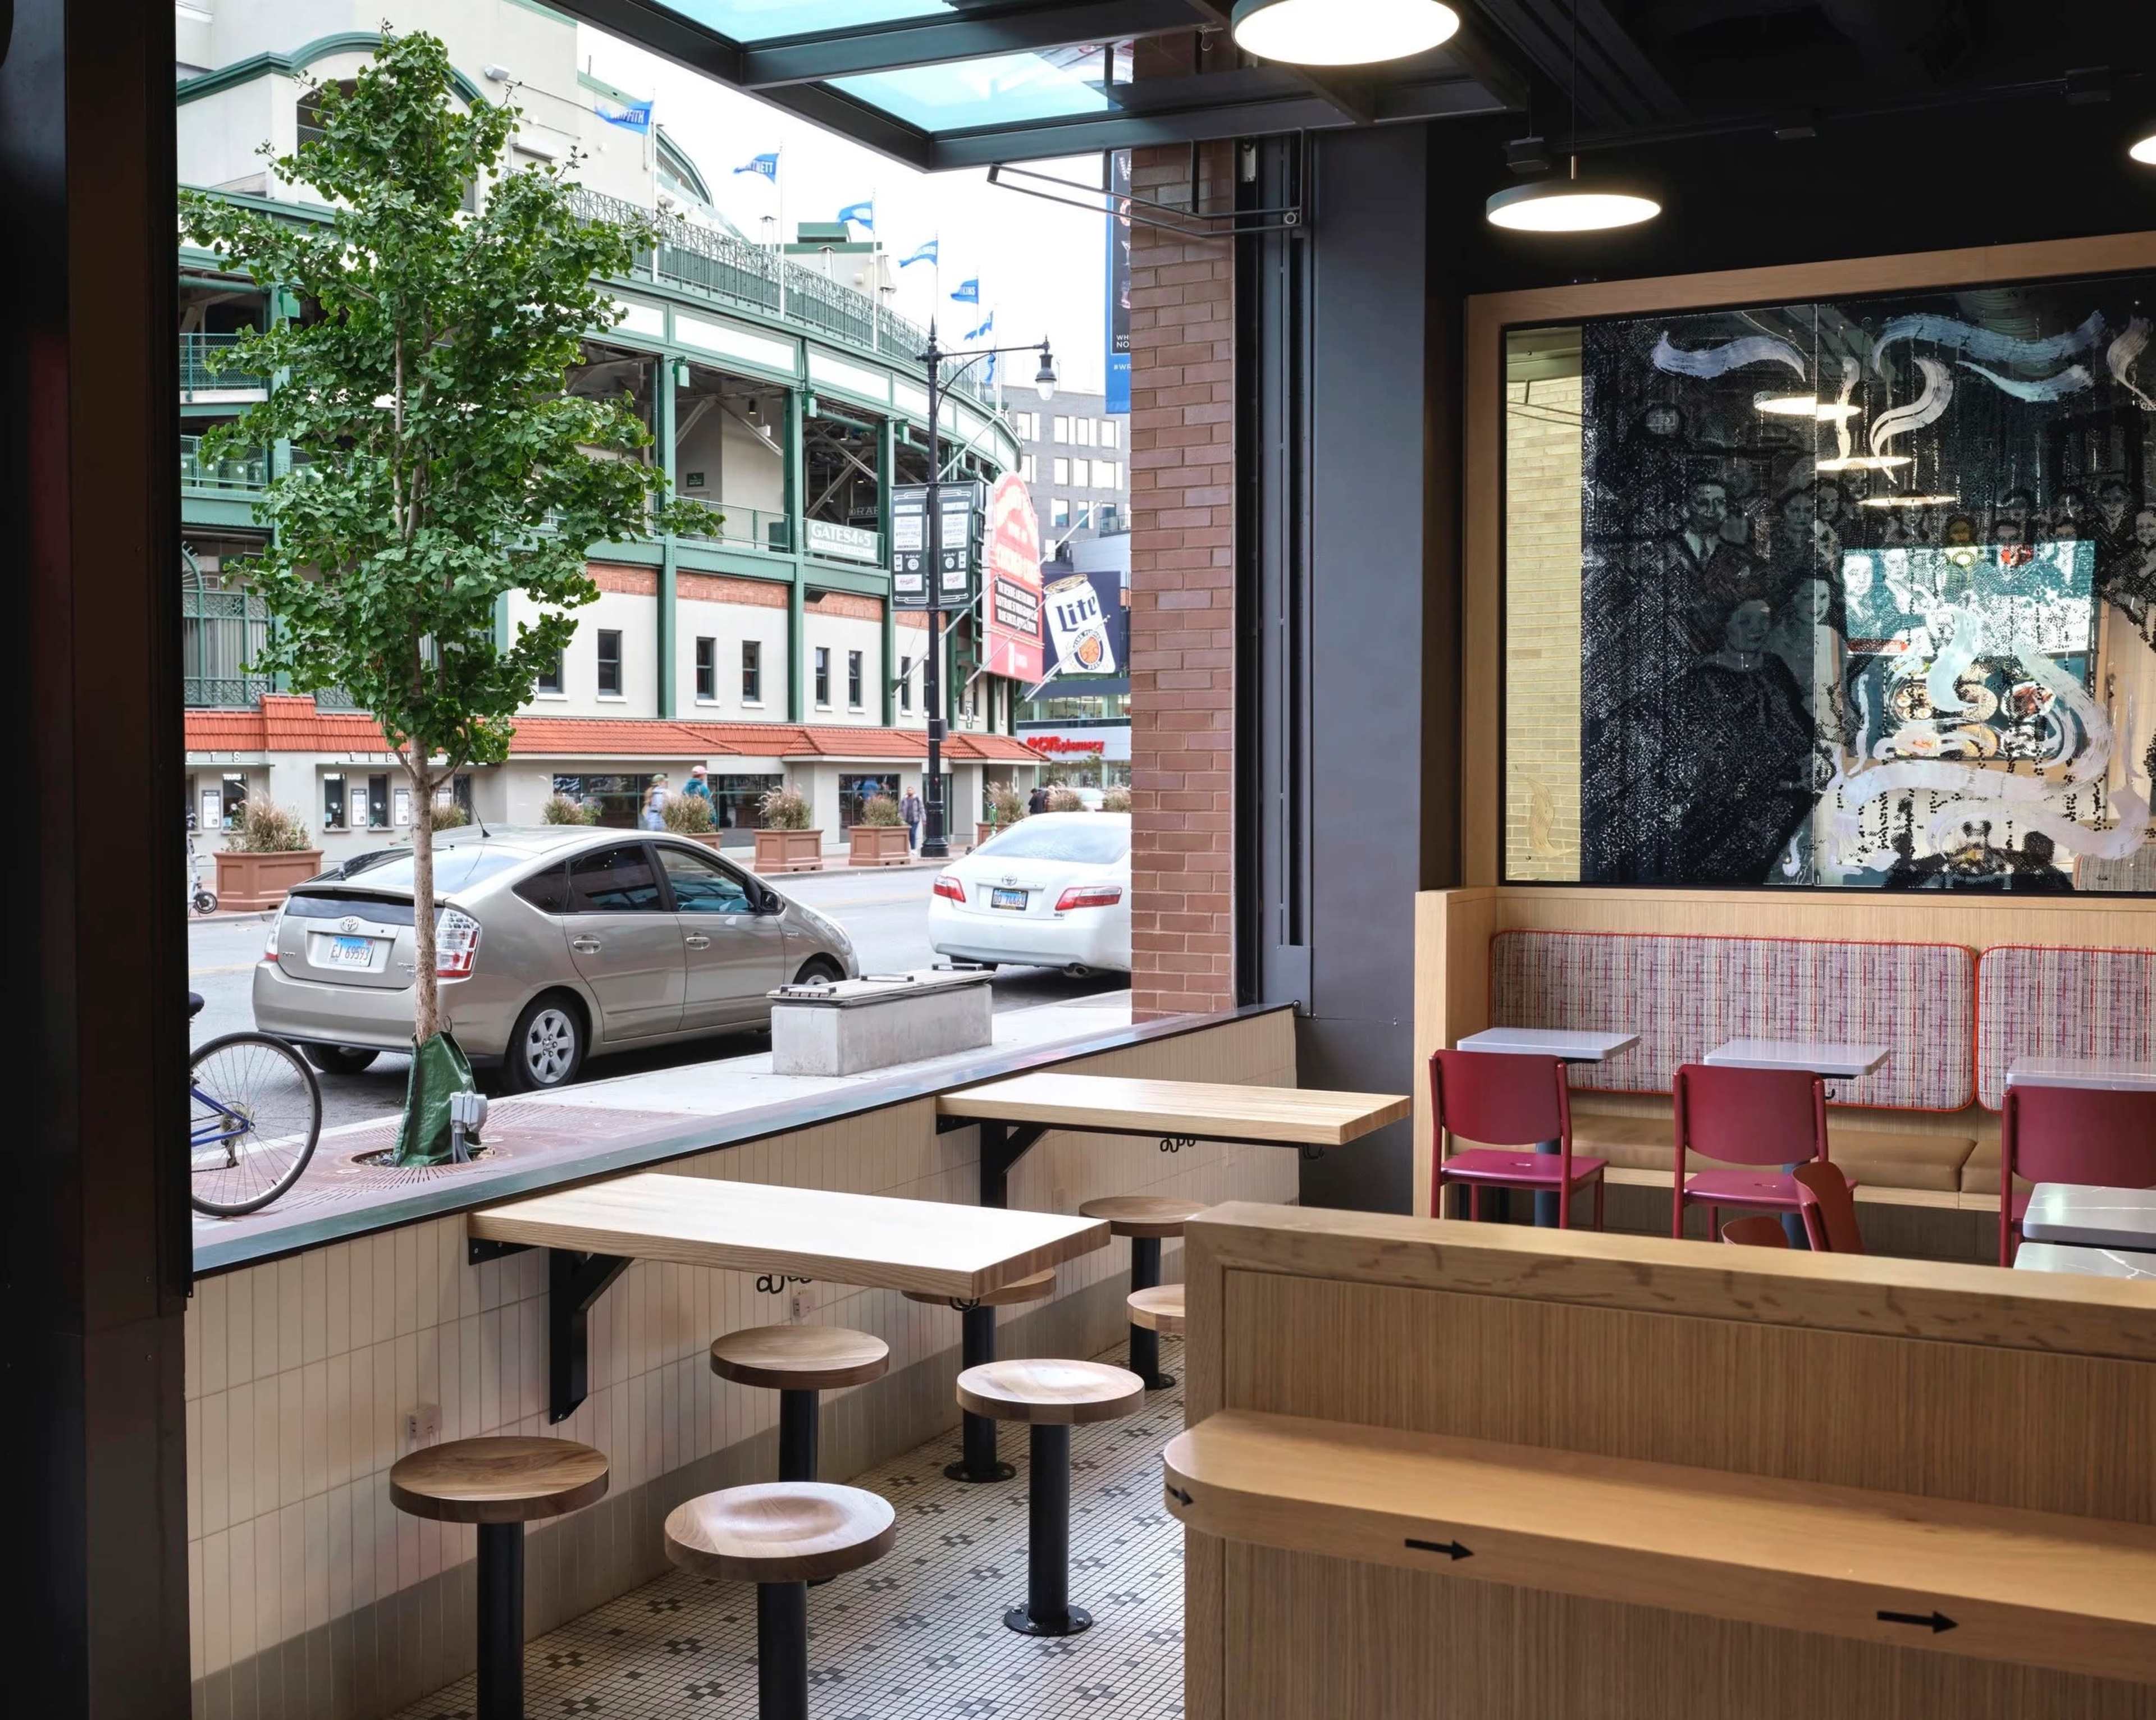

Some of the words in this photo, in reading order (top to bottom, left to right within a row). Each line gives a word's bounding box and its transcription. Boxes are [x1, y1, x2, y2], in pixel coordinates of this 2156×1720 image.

[811, 523, 851, 543] GATES
[1056, 596, 1097, 632] Lite
[331, 945, 342, 958] EJ
[345, 946, 370, 960] 69593
